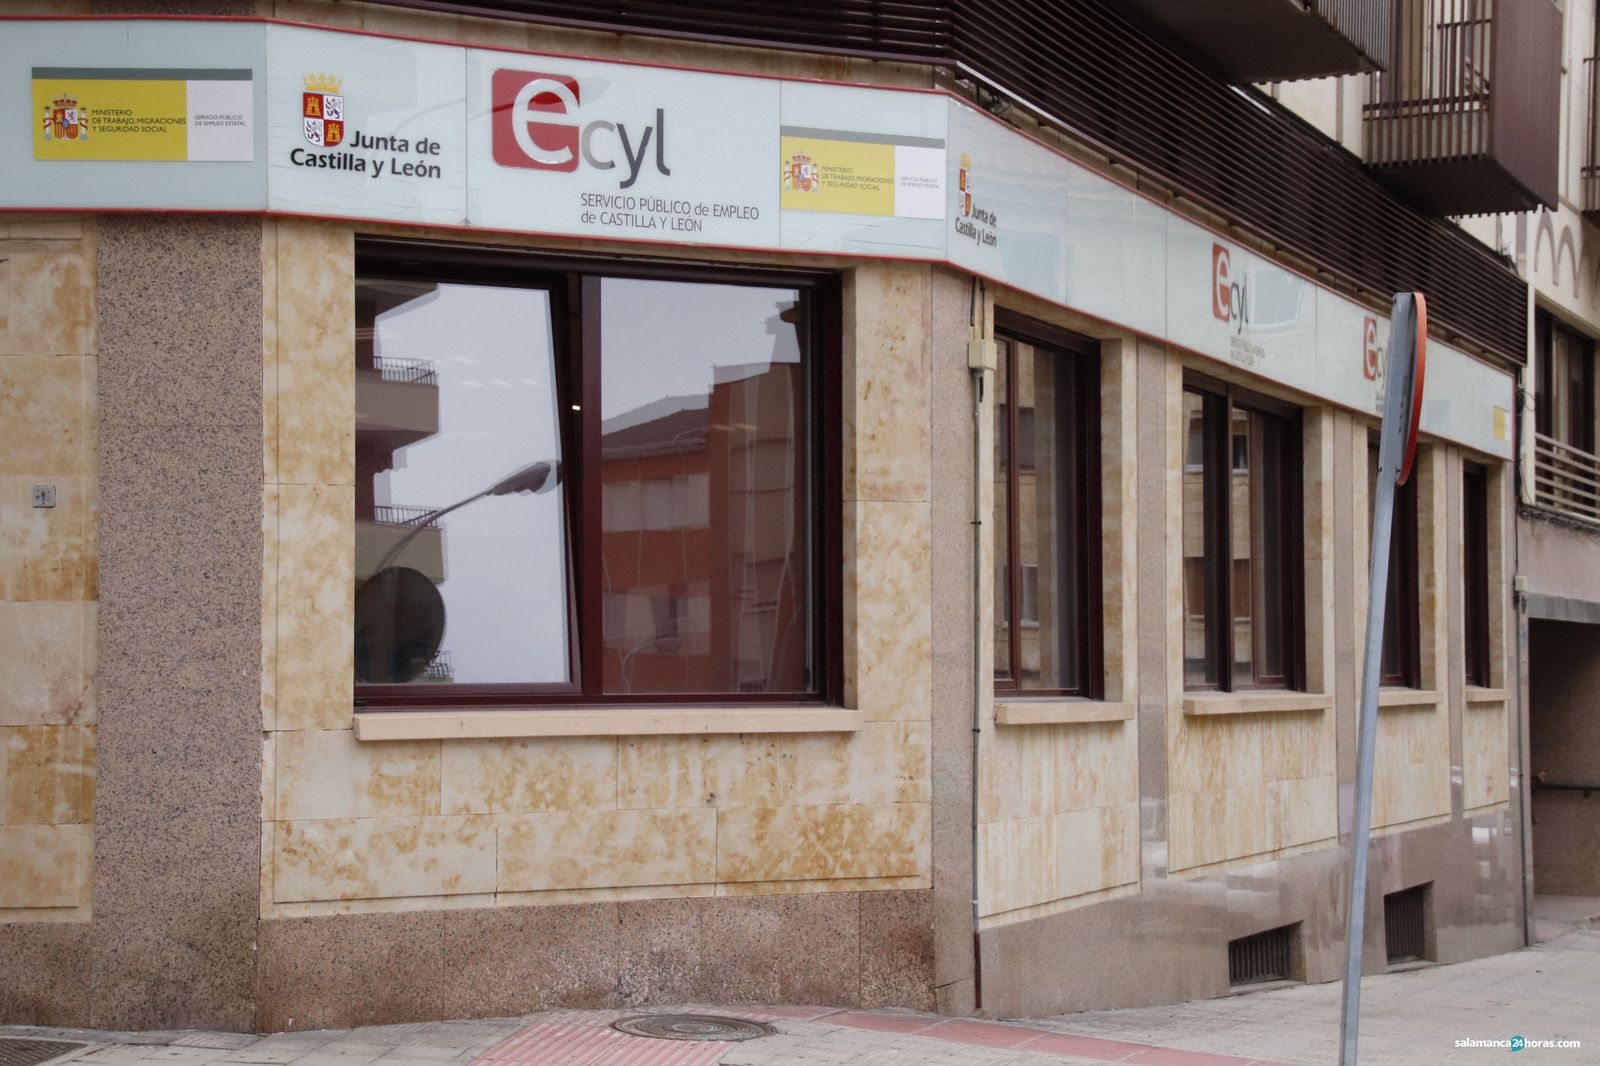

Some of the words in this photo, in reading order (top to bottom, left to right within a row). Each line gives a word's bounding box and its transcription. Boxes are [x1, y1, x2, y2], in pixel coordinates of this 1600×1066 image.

[350, 131, 409, 152] Junta
[415, 138, 441, 155] de
[512, 78, 671, 189] ecyl
[291, 148, 366, 172] Castilla
[371, 159, 385, 178] y
[391, 158, 441, 179] León
[581, 193, 636, 210] SERVICIO
[639, 195, 691, 215] PÚBLICO
[695, 203, 710, 216] de
[713, 204, 760, 220] EMPLEO
[972, 203, 988, 224] Junta
[989, 211, 997, 228] de
[581, 211, 597, 224] de
[600, 211, 657, 229] CASTILLA
[659, 217, 668, 229] Y
[671, 214, 702, 232] LEÓN
[955, 217, 976, 240] Castilla
[977, 229, 982, 246] y
[982, 228, 997, 248] León
[1216, 250, 1248, 335] ecyl
